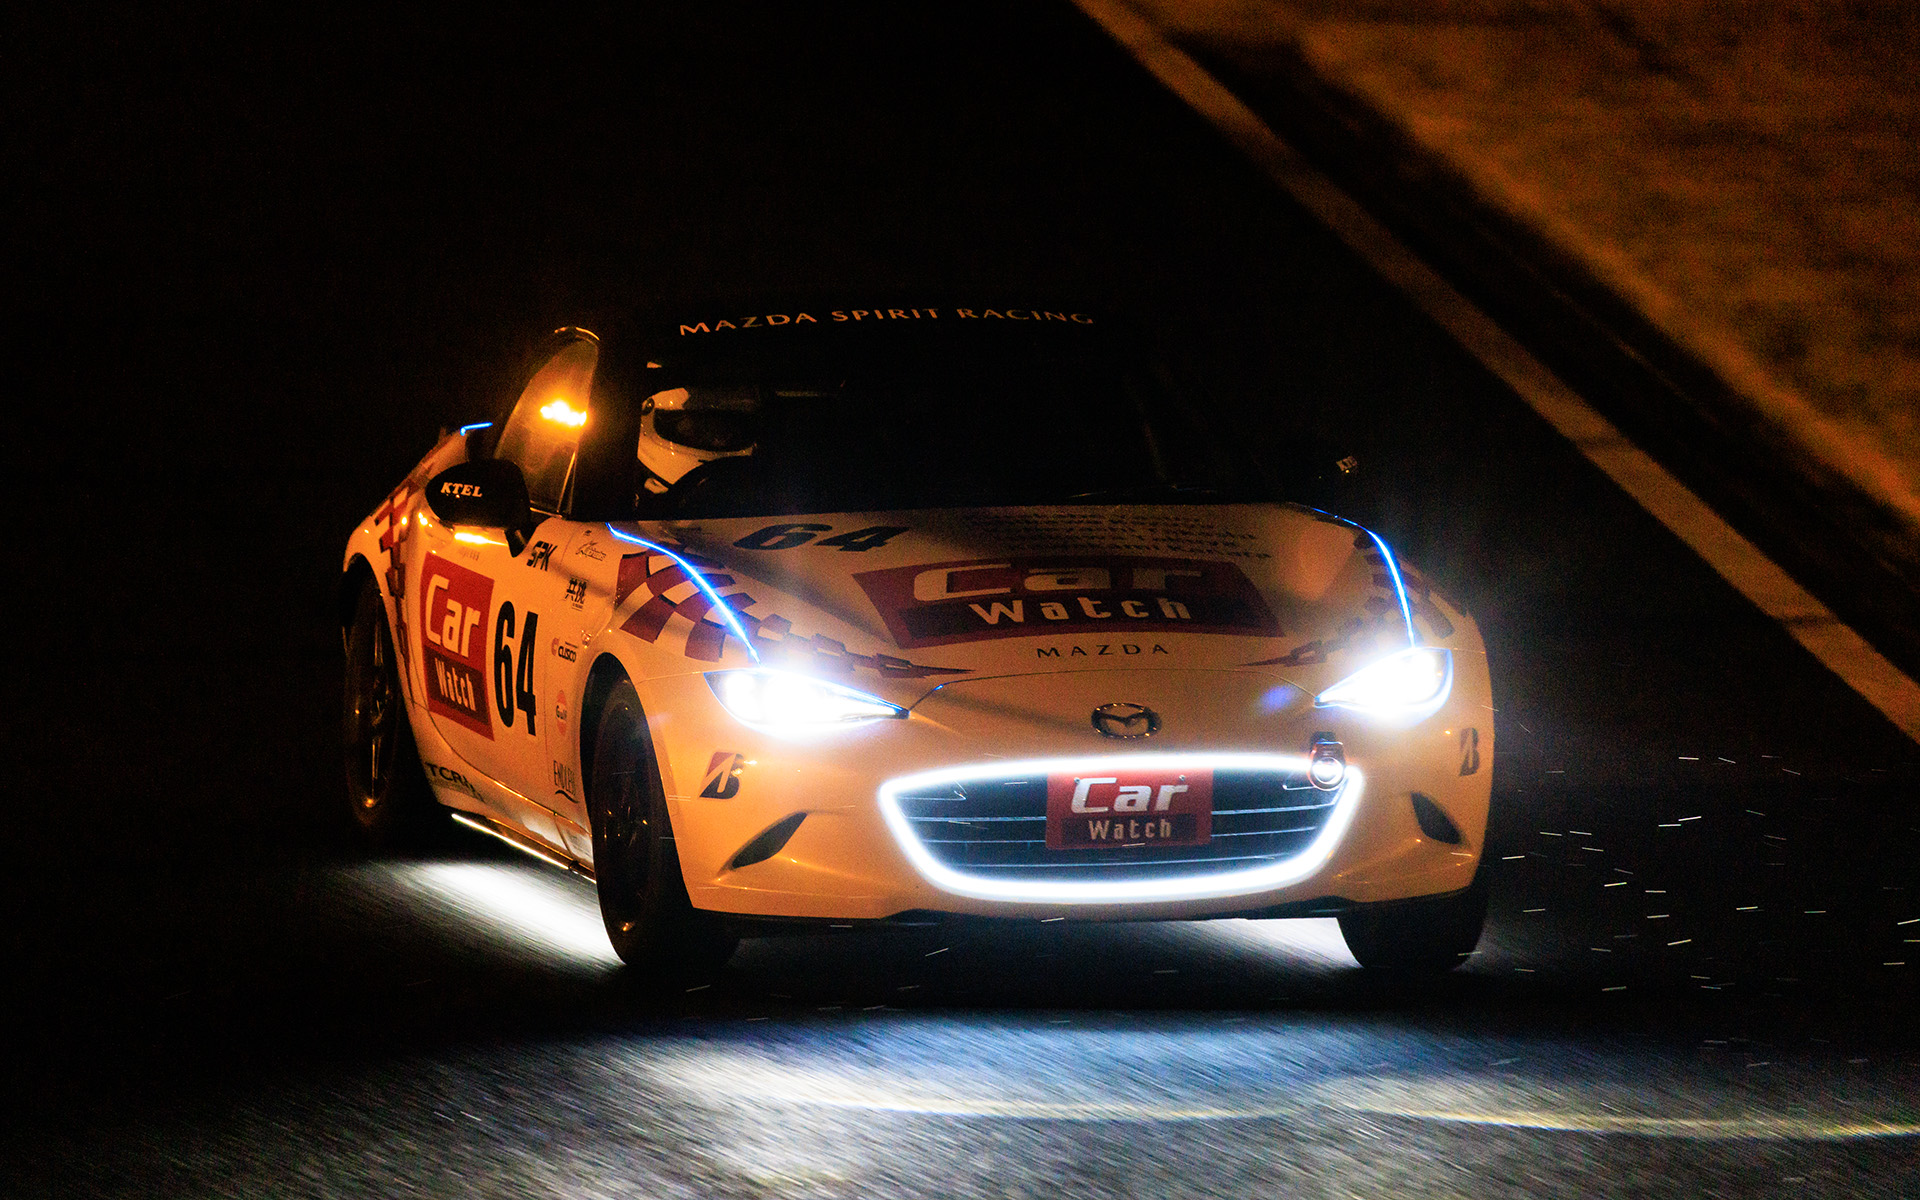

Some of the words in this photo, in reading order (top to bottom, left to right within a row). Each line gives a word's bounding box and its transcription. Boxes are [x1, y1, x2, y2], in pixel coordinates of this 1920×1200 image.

[678, 311, 818, 336] MAZDA
[830, 307, 941, 323] SPIRIT
[956, 307, 1094, 325] RACING
[440, 481, 483, 498] KTEL
[732, 522, 911, 552] 64
[526, 540, 558, 572] SPK
[914, 563, 1203, 602] Car
[425, 573, 481, 660] Car
[968, 596, 1193, 626] Watch
[1036, 643, 1170, 659] MAZDA
[494, 600, 539, 737] 64
[433, 656, 477, 713] Watch
[1070, 776, 1189, 814] Car
[1087, 818, 1172, 841] Watch
